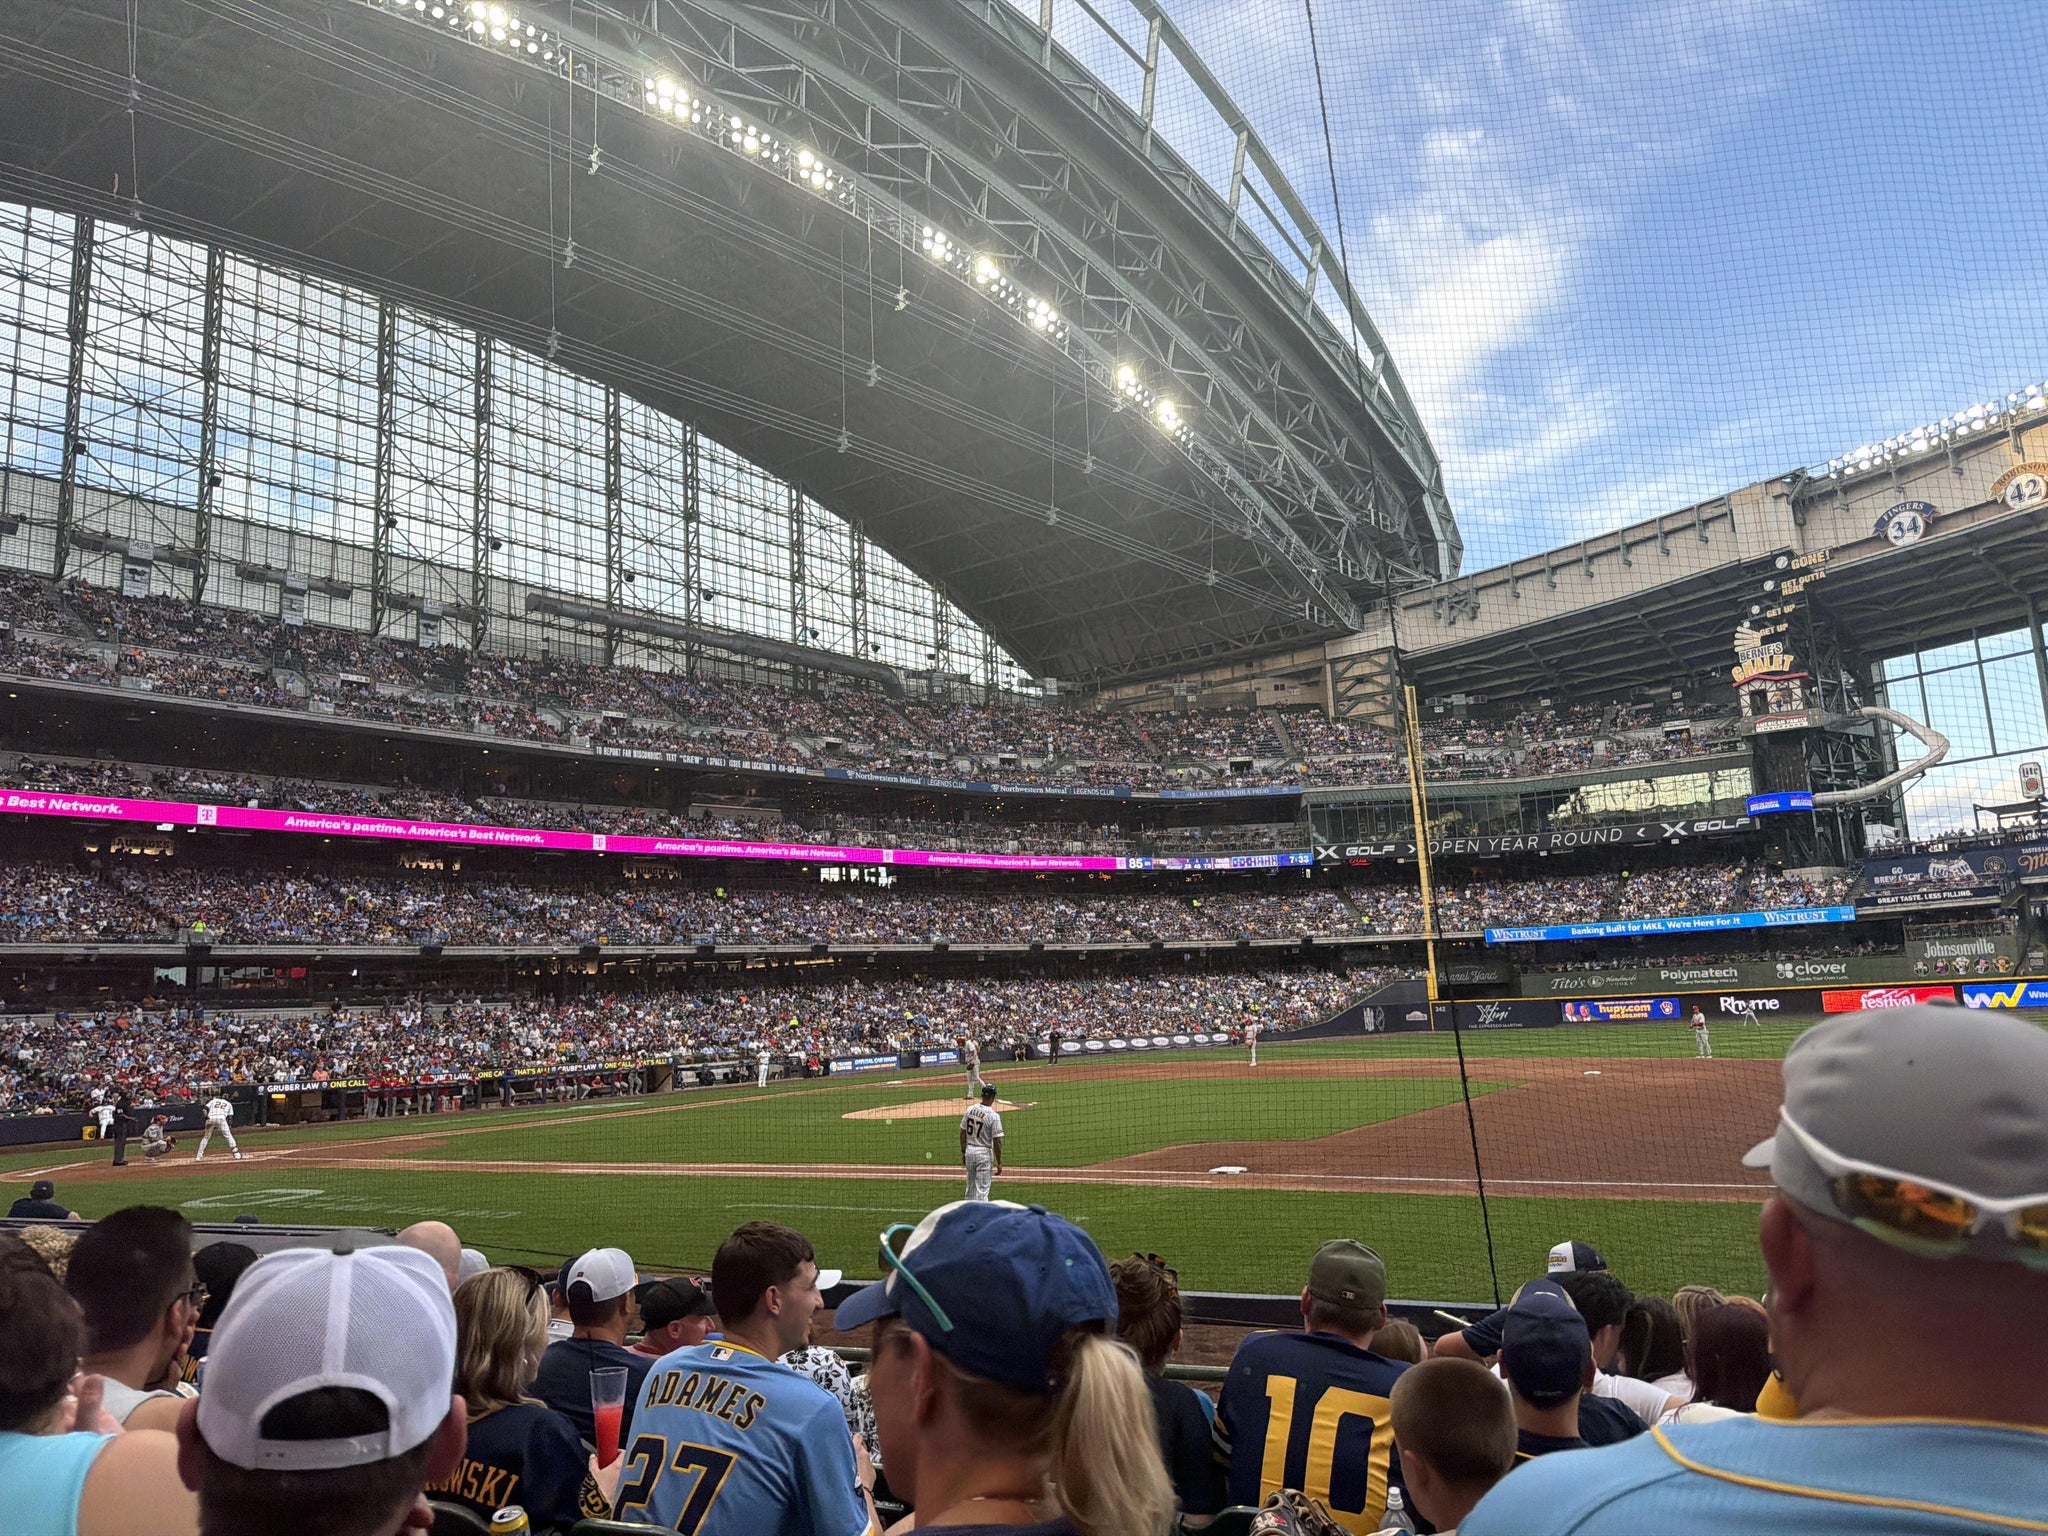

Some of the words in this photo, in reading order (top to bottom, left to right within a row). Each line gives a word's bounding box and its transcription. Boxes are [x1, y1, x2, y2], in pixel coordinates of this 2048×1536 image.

[1998, 462, 2048, 487] ROBINSON
[2010, 478, 2042, 505] 42
[1882, 501, 1925, 522] FINGERS
[1892, 515, 1922, 540] 34
[1791, 550, 1831, 570] GONE!
[1781, 578, 1797, 590] GET
[1798, 571, 1827, 583] OUTTA
[1782, 583, 1805, 597] HERE
[1766, 607, 1782, 618] GET
[1783, 603, 1796, 614] UP
[1760, 625, 1775, 637] GET
[1776, 623, 1789, 632] UP
[1740, 643, 1783, 662] BERNIE'S
[1731, 654, 1795, 682] CHALET
[1756, 719, 1785, 728] AMERICAN
[1786, 717, 1807, 725] FAMILY
[665, 753, 677, 762] TEXT
[2022, 767, 2039, 778] Lite
[855, 772, 899, 783] Northwestern
[899, 776, 921, 785] Mutual
[927, 779, 952, 788] LEGENDS
[952, 781, 967, 789] CLUB
[1000, 785, 1044, 794] Northwestern
[1044, 786, 1067, 795] Mutual
[1073, 787, 1099, 796] LEGENDS
[7, 795, 46, 809] Best
[48, 798, 123, 814] Network.
[284, 816, 351, 830] America's
[352, 820, 406, 834] pastime.
[408, 825, 467, 839] America's
[469, 829, 494, 840] Best
[495, 831, 544, 844] Network.
[1345, 844, 1396, 857] GOLF
[1428, 838, 1480, 854] OPEN
[1488, 836, 1539, 851] YEAR
[1550, 828, 1623, 848] ROUND
[1693, 816, 1750, 833] GOLF
[655, 841, 703, 852] America's
[704, 844, 744, 854] pastime.
[745, 846, 789, 856] America's
[790, 849, 809, 857] Best
[810, 850, 847, 859] Network.
[928, 855, 963, 864] America's
[964, 857, 993, 866] pastime.
[994, 858, 1030, 867] America's
[1031, 859, 1048, 867] Best
[1049, 860, 1083, 868] Network.
[1891, 866, 1904, 875] GO
[1877, 896, 1898, 905] GREAT
[1900, 894, 1923, 903] TASTE.
[1924, 892, 1942, 901] LESS
[1943, 890, 1974, 899] FILLING.
[1491, 929, 1546, 940] WINTRUST
[1571, 925, 1605, 936] Banking
[1606, 924, 1626, 933] Built
[1627, 922, 1641, 932] for
[1667, 919, 1692, 929] We're
[1693, 918, 1714, 928] Here
[1717, 917, 1731, 926] For
[1733, 916, 1741, 925] It
[1763, 910, 1829, 922] WINTRUST
[1924, 940, 1996, 959] Johnsonville
[1471, 969, 1498, 983] Yard
[1661, 966, 1738, 981] Polymatech
[1795, 961, 1847, 976] clover
[1551, 977, 1586, 990] Tito's
[1606, 973, 1637, 983] Handmade
[1861, 993, 1916, 1009] festival
[1599, 1003, 1651, 1015] hupy.com
[514, 1067, 537, 1076] THAT'S
[583, 1063, 597, 1071] LAW
[604, 1061, 618, 1069] ONE
[454, 1072, 470, 1081] LAW
[478, 1070, 493, 1079] ONE
[267, 1084, 300, 1093] GRUBER
[302, 1082, 319, 1091] LAW
[330, 1081, 347, 1089] ONE
[348, 1079, 369, 1088] CALL.
[213, 1100, 228, 1110] 22
[966, 1117, 984, 1139] 67
[645, 1370, 766, 1432] ADAMES
[1259, 1375, 1396, 1536] 10
[425, 1457, 520, 1509] WSKI
[611, 1433, 738, 1536] 27
